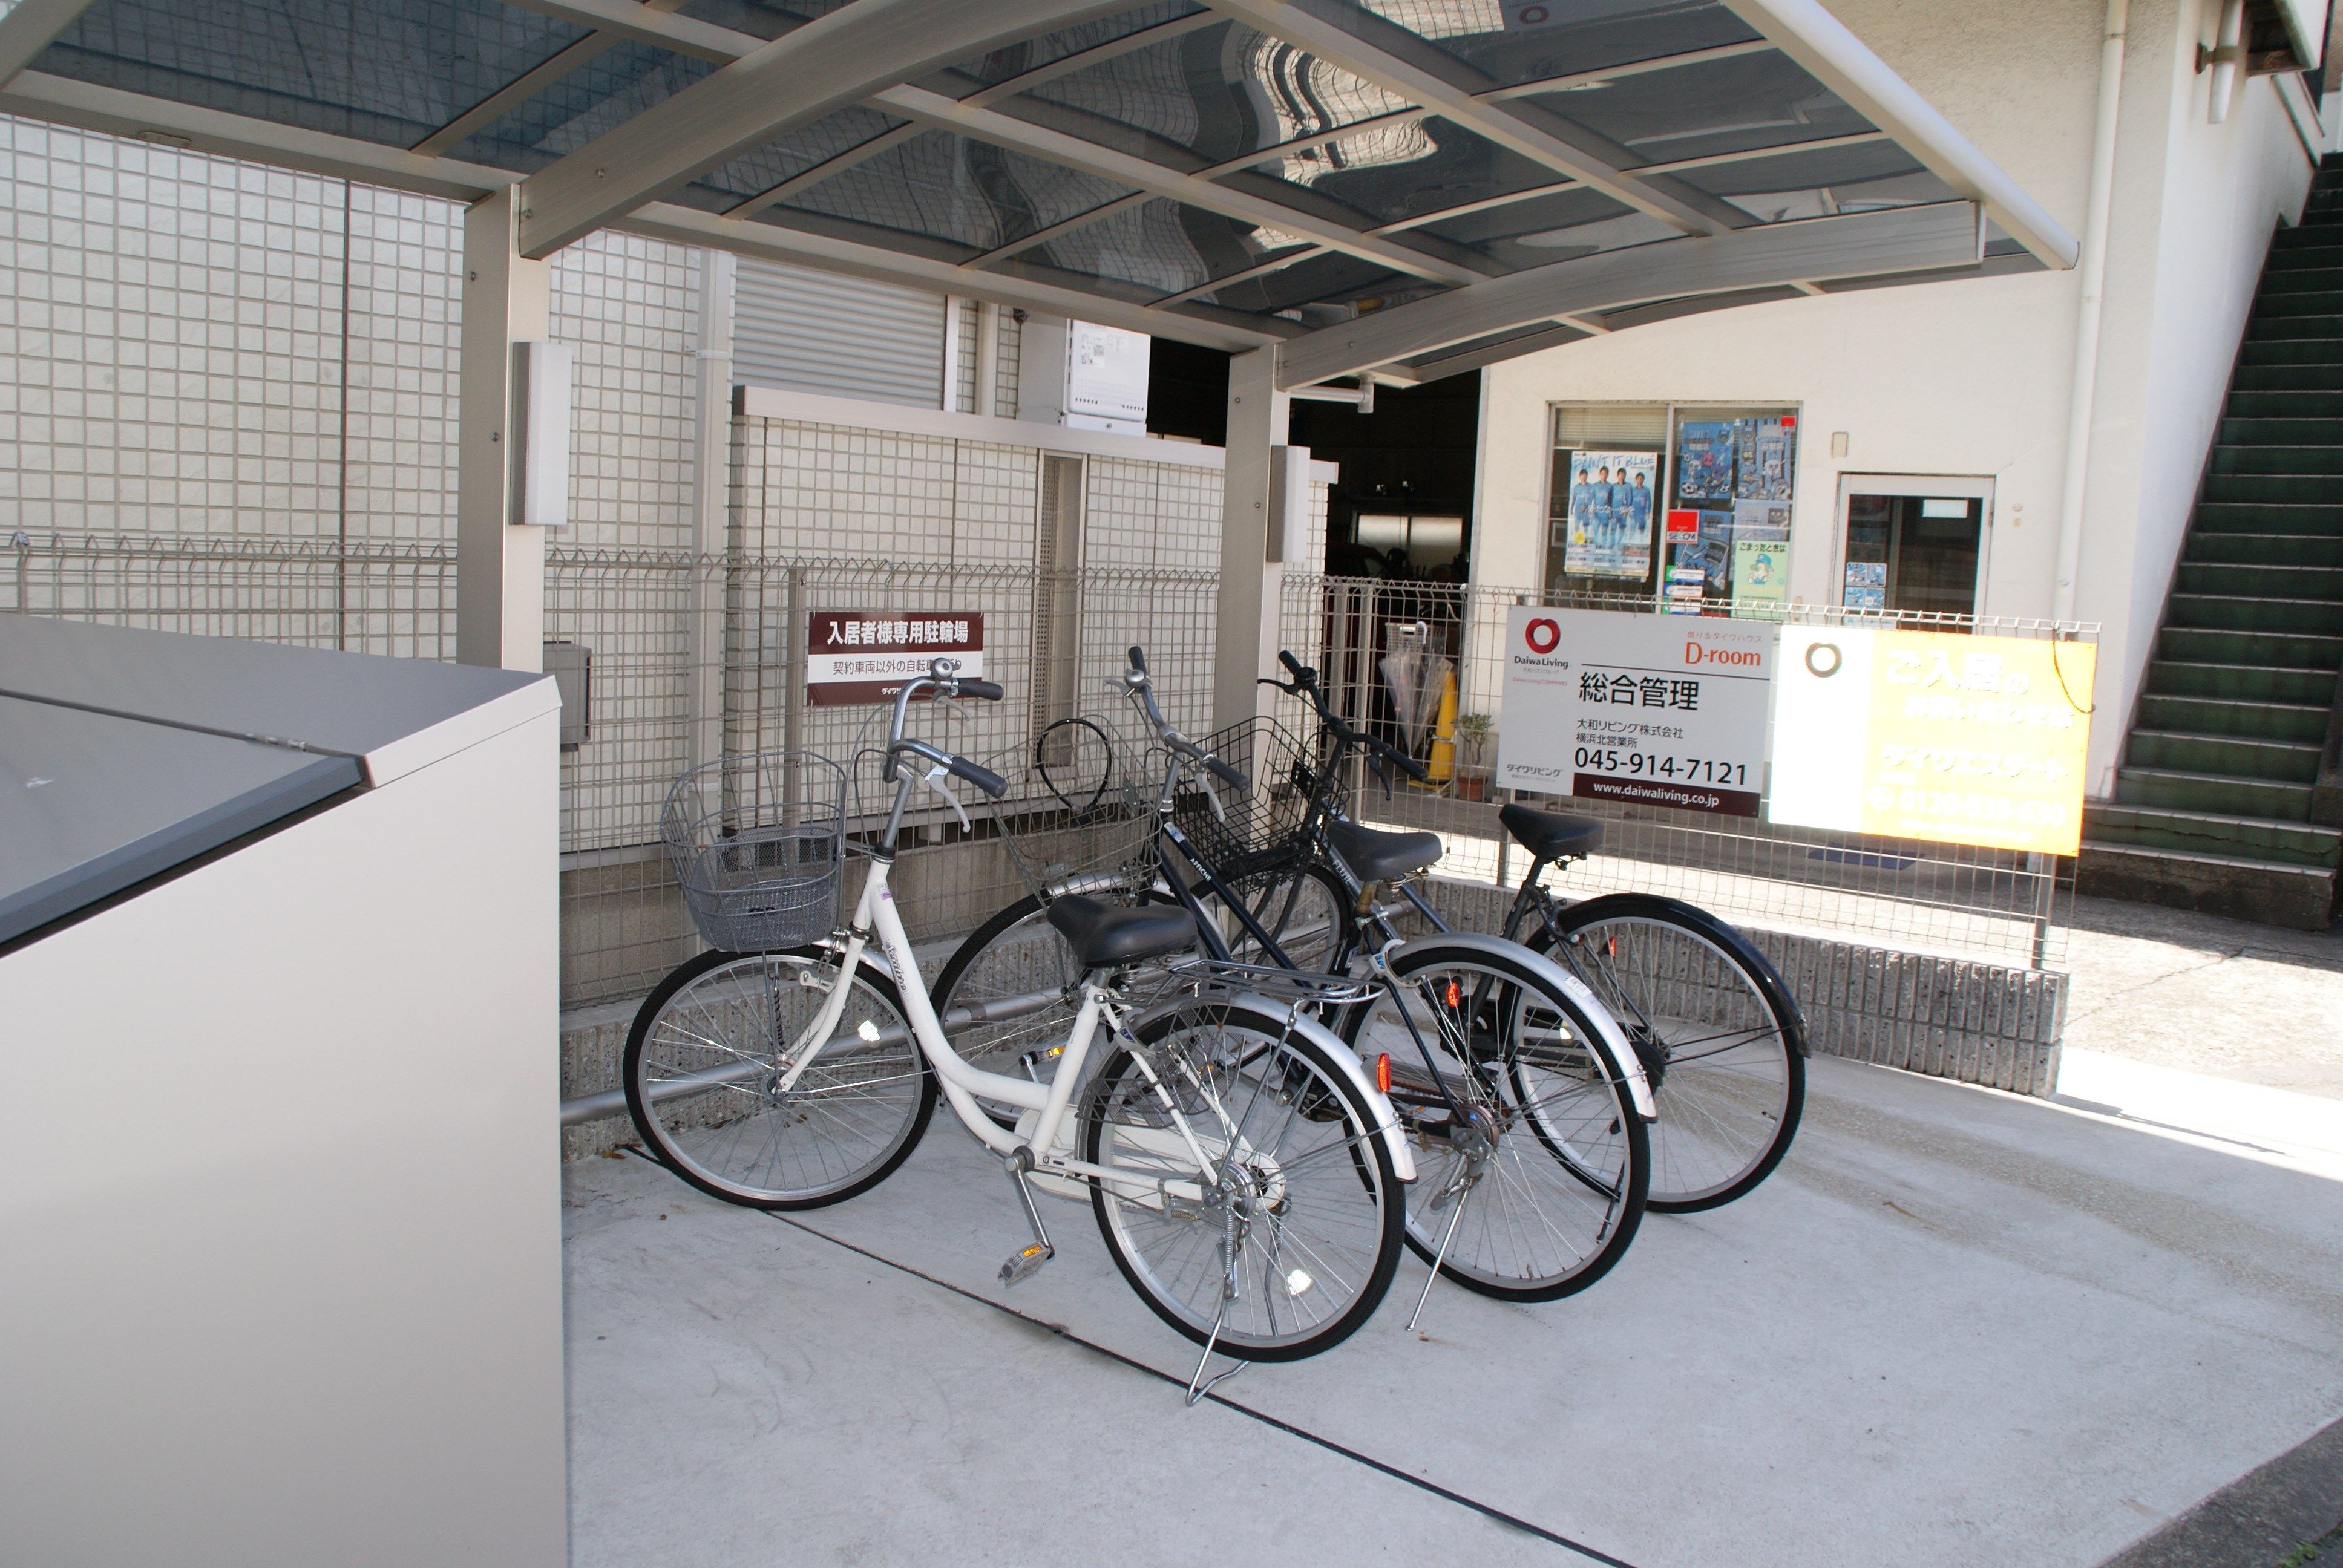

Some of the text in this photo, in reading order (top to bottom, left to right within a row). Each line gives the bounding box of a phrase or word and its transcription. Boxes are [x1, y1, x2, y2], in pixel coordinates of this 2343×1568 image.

[827, 621, 968, 645] 入居者様専用駐輪場
[1686, 630, 1763, 643] 借りるダイワハウス
[1514, 656, 1568, 670] Daiwa Living
[1685, 641, 1761, 666] D-room
[833, 658, 962, 675] 契約車両以外の自転車り
[1579, 672, 1699, 710] 総合管理
[1577, 718, 1683, 739] 大和リビング株式会社
[1576, 733, 1638, 748] 横浜北営業所
[1506, 764, 1563, 777] ダイワリビング
[1575, 747, 1745, 785] 045-914-7121
[1594, 783, 1720, 808] www.daiwaliving.co.jp
